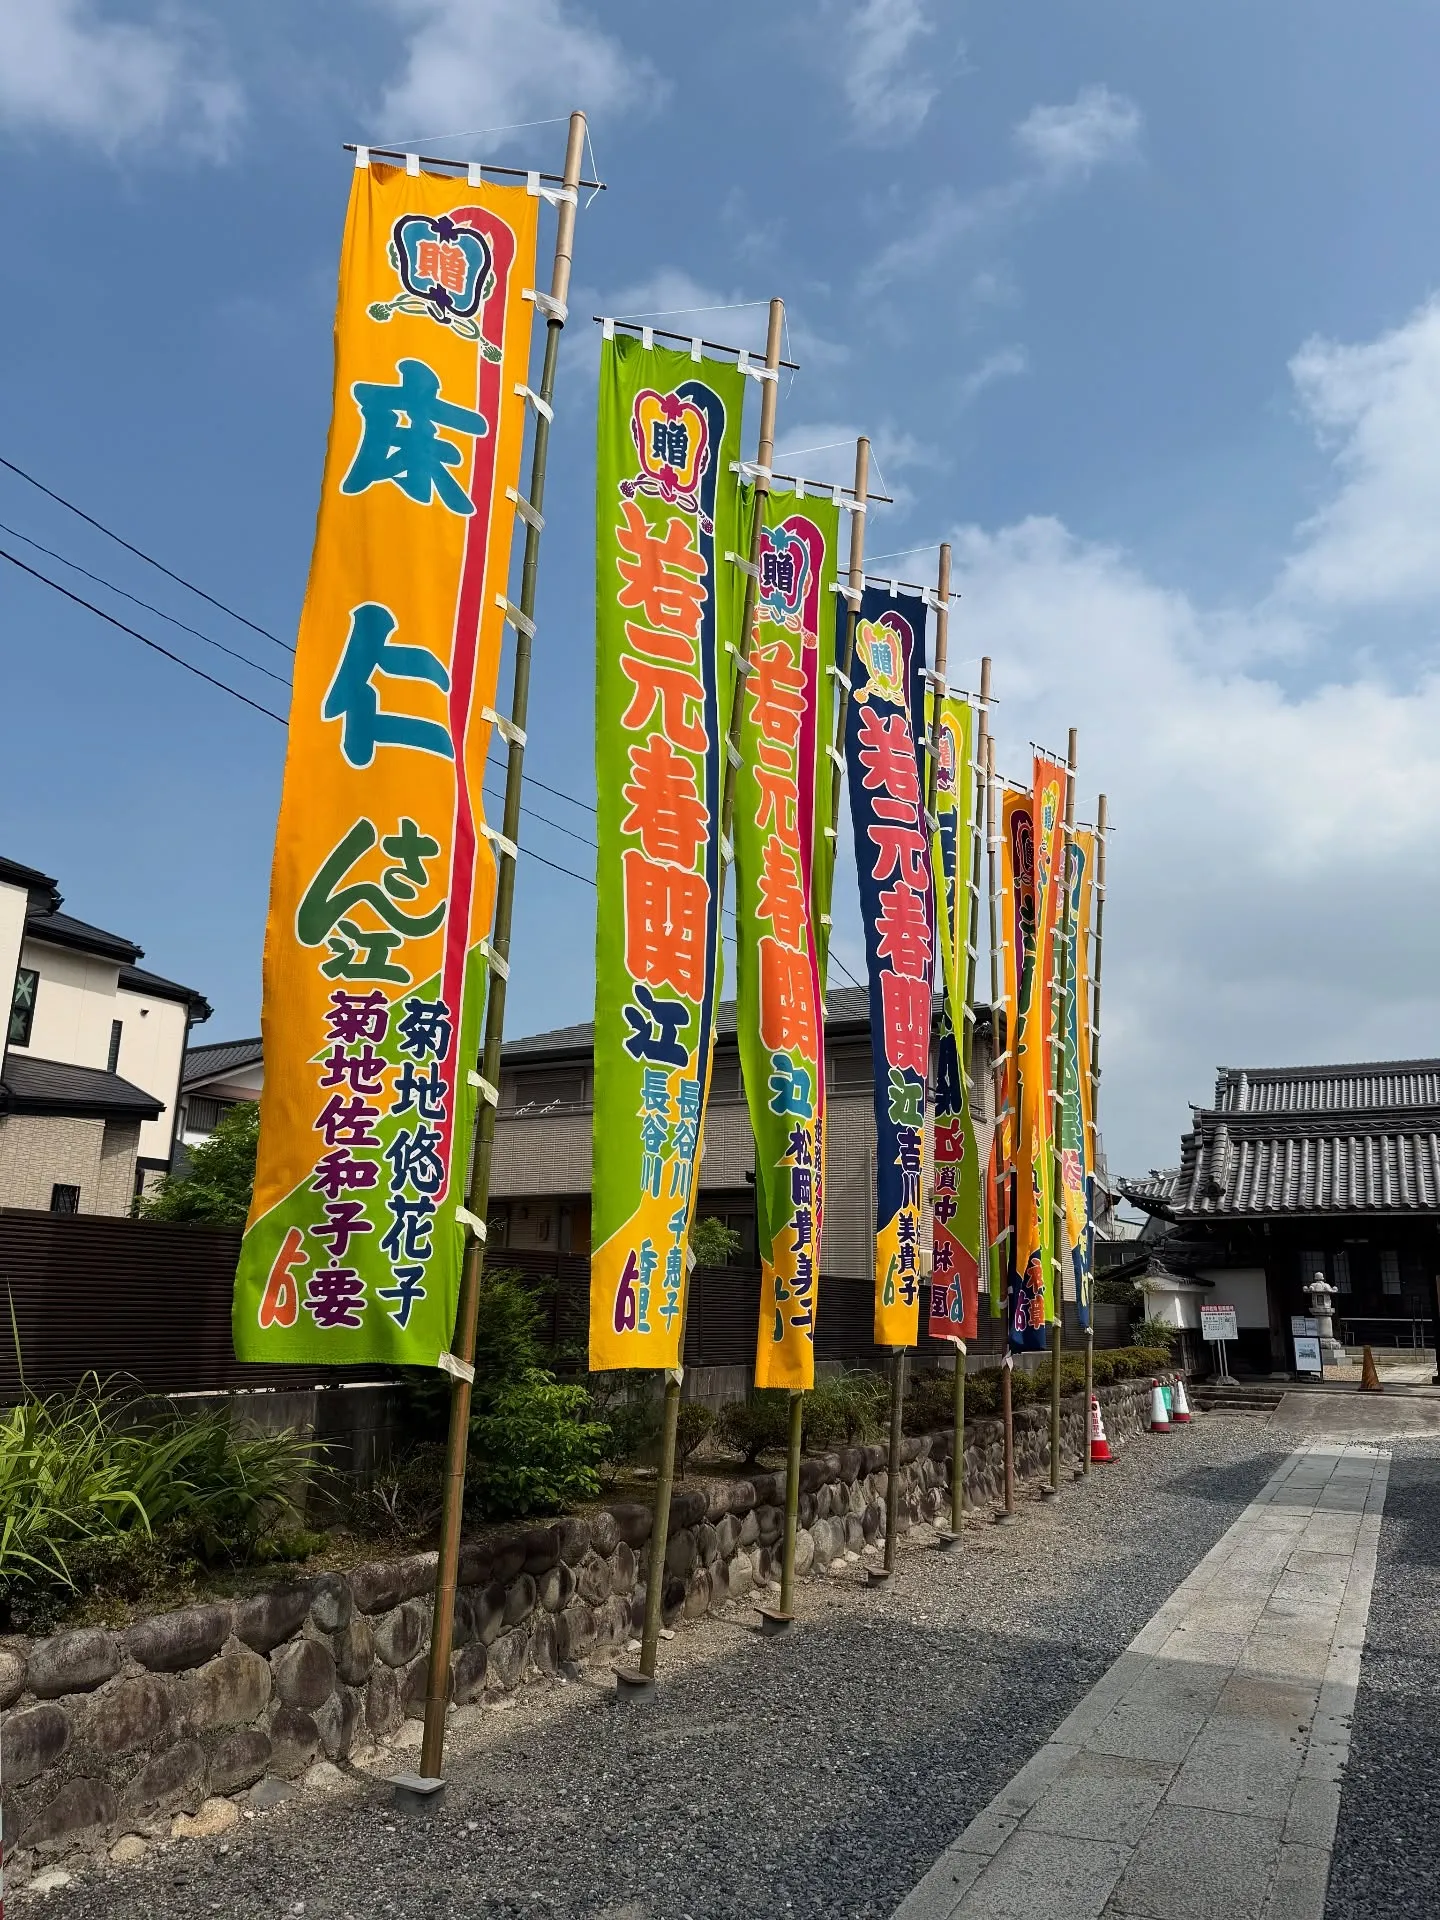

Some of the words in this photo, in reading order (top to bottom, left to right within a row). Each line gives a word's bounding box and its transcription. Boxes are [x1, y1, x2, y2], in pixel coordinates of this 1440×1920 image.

[415, 241, 468, 293] 贈
[652, 420, 688, 469] 贈
[763, 552, 795, 593] 贈
[376, 997, 452, 1330] 菊地悠花子
